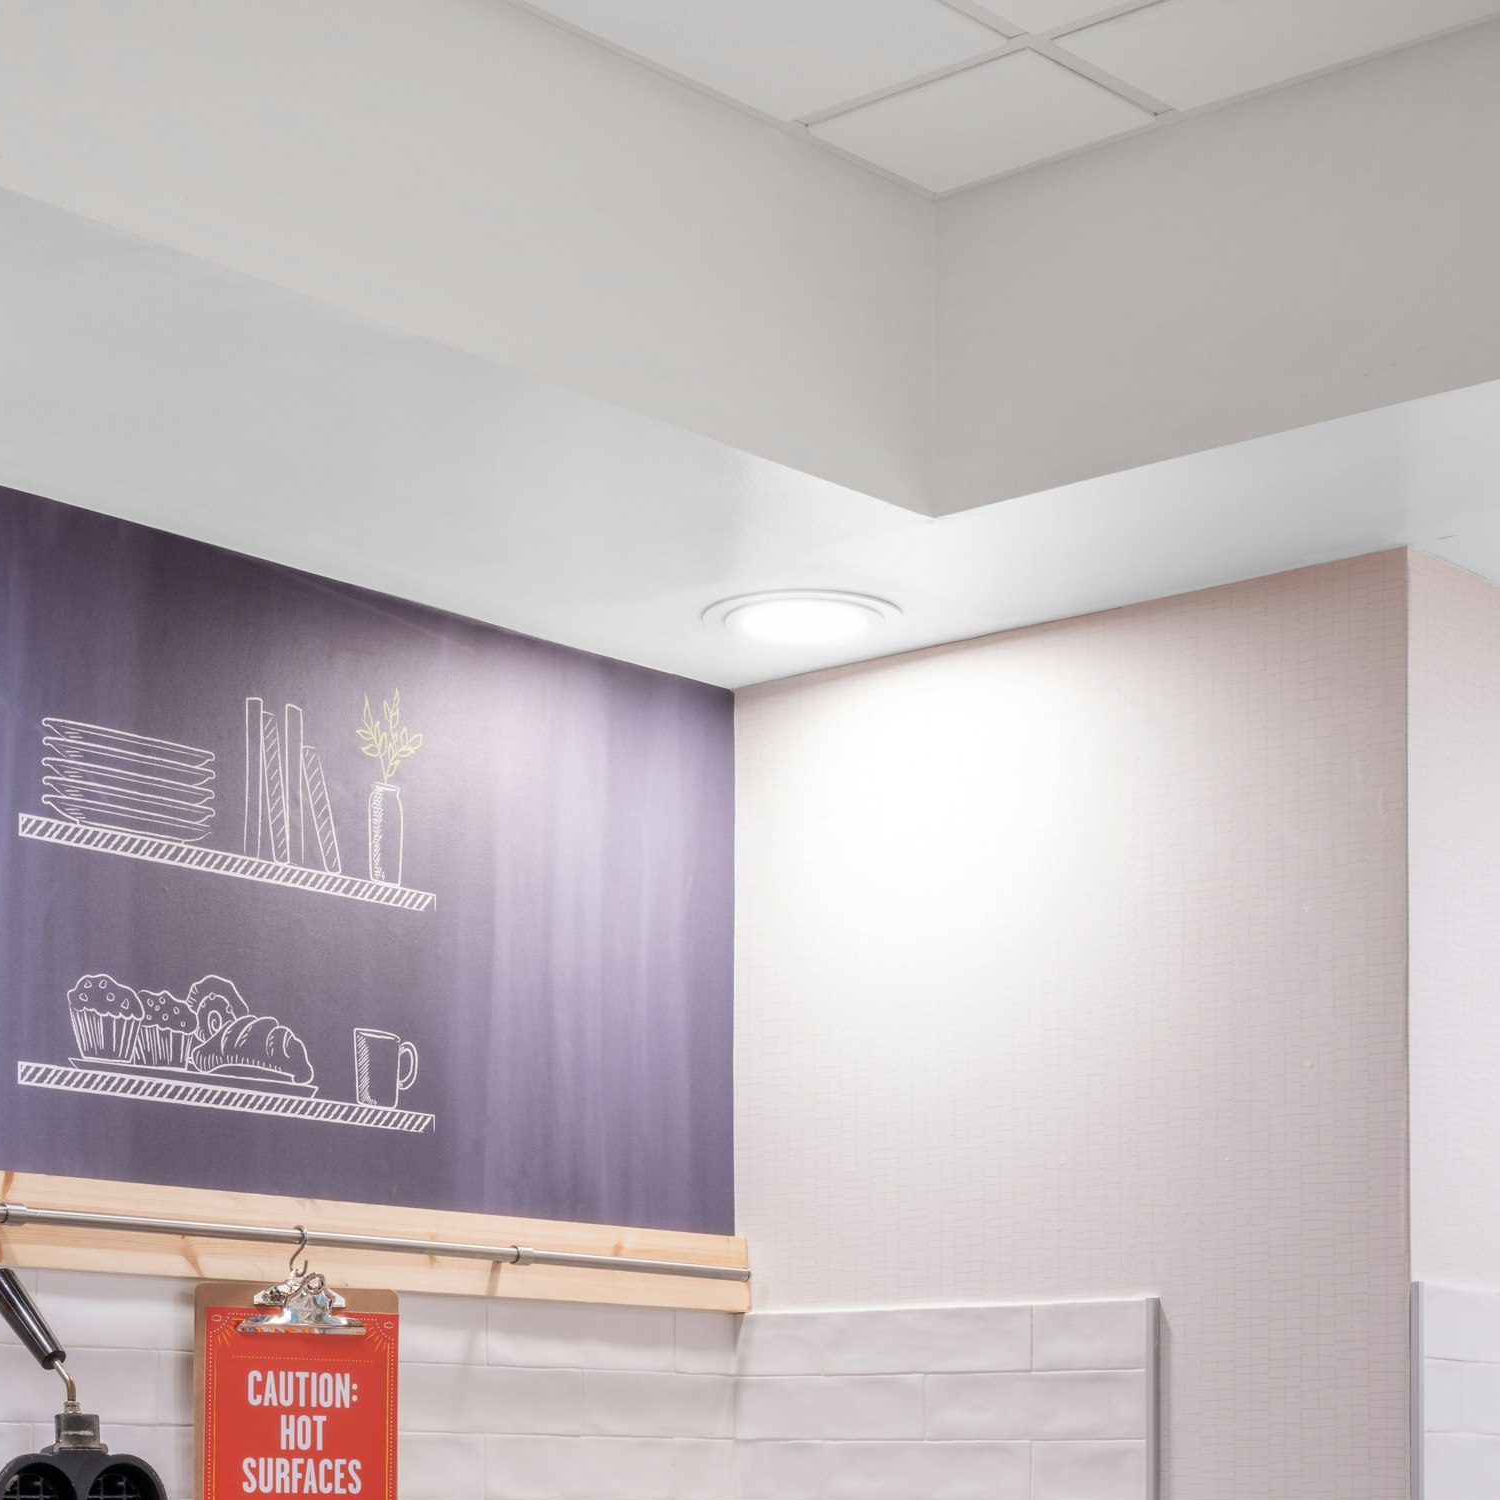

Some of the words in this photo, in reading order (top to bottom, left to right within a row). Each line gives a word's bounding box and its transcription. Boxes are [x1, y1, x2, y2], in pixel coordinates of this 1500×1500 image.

[247, 1370, 358, 1408] CAUTION:
[280, 1415, 327, 1451] HOT
[242, 1458, 362, 1494] SURFACES
